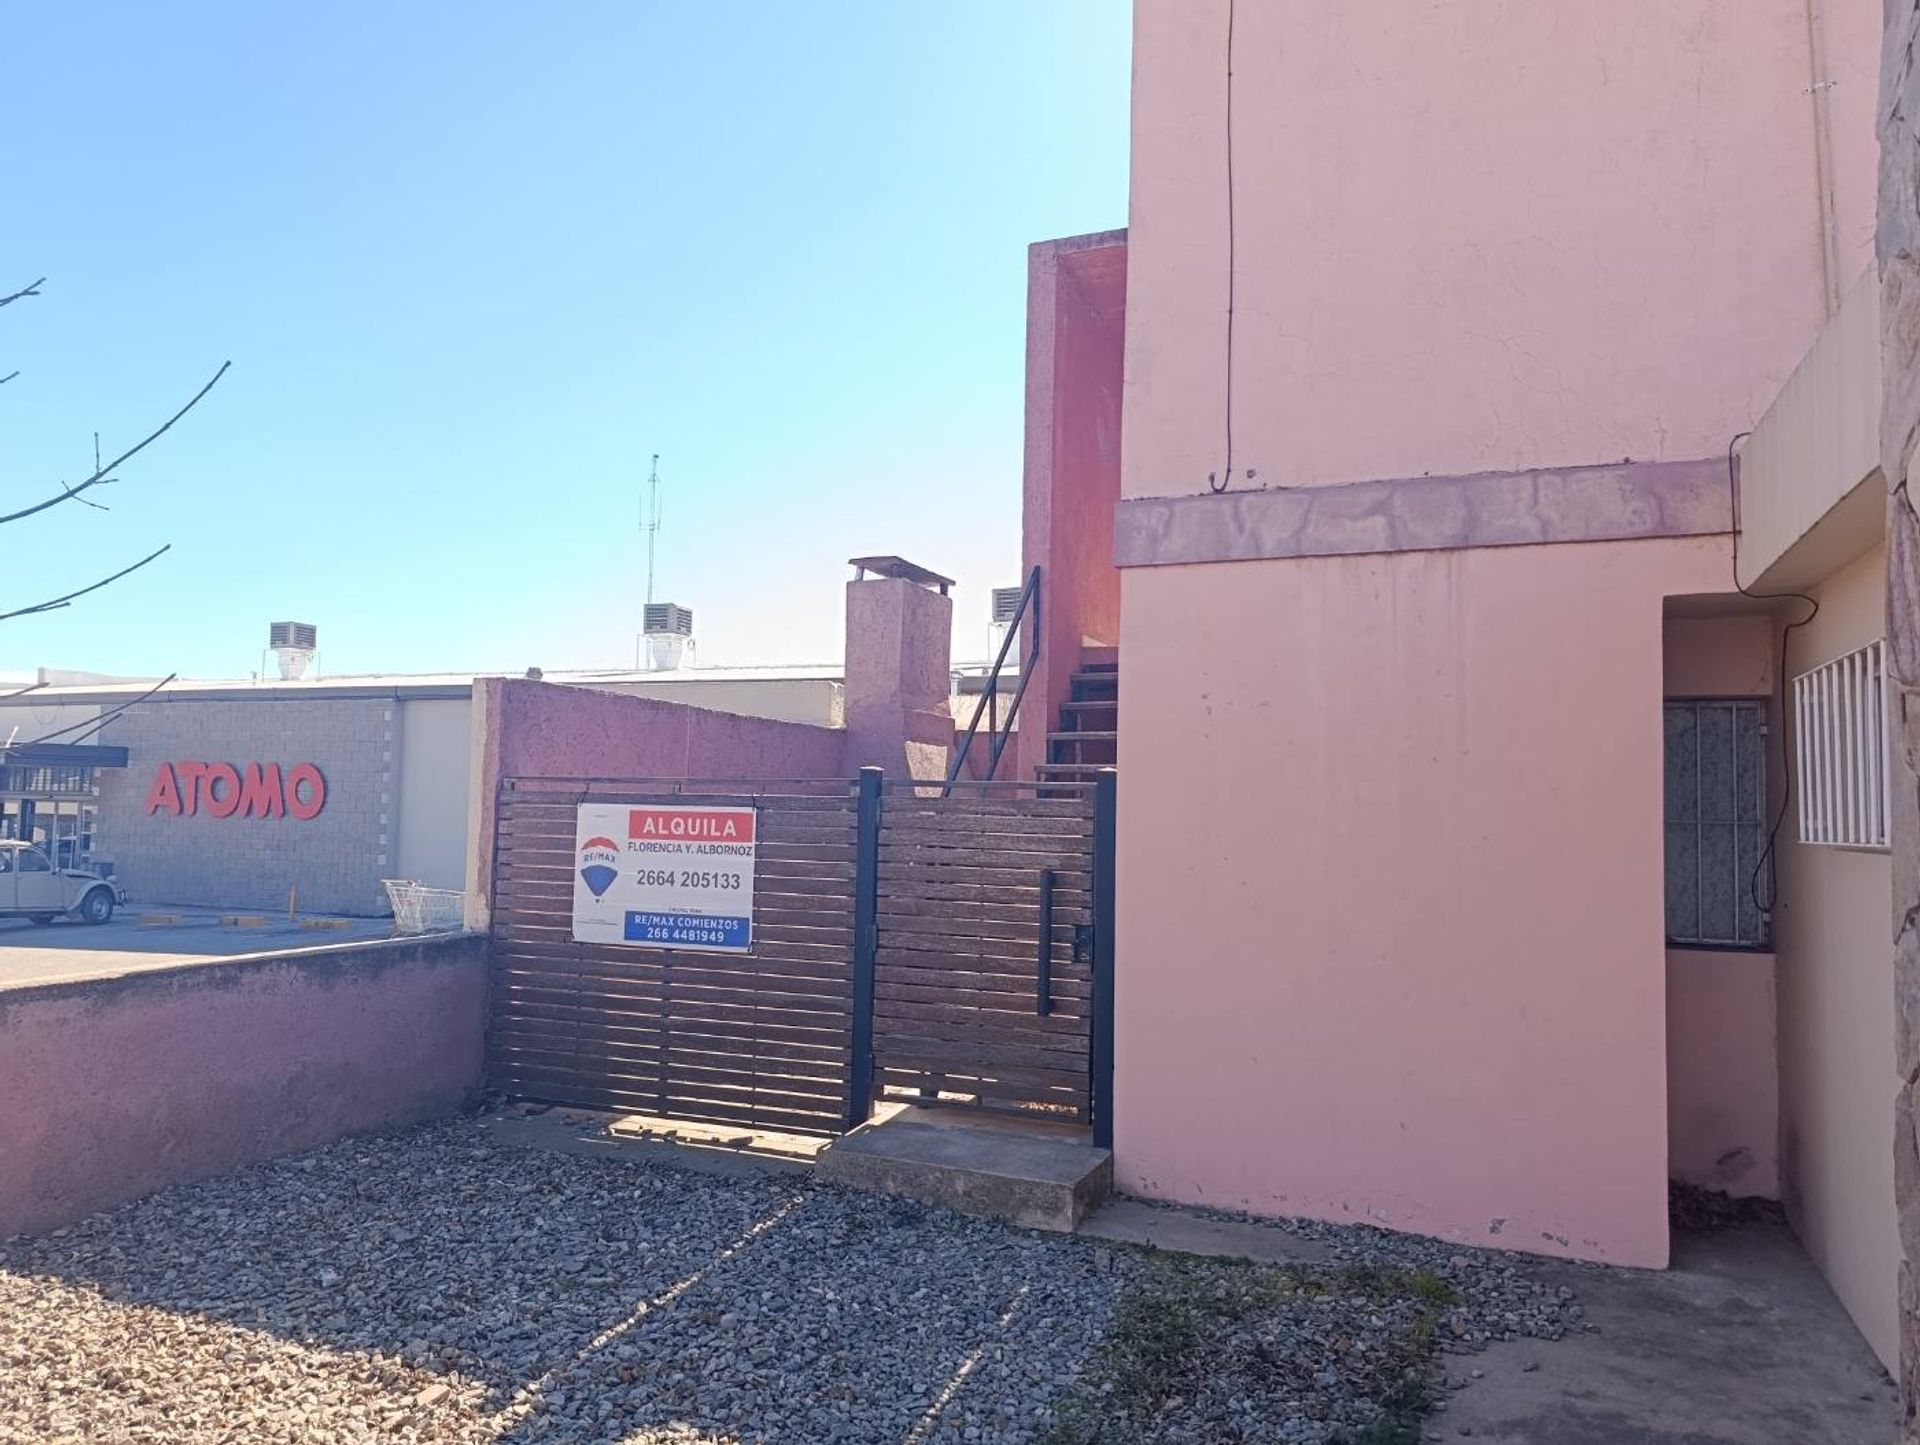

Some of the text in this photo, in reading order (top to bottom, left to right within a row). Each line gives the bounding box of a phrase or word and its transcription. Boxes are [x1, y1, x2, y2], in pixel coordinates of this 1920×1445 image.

[145, 760, 326, 820] ATOMO
[642, 817, 737, 837] ALQUILA
[627, 841, 683, 854] FLORENCIA
[695, 843, 753, 857] ALBORNOZ
[583, 852, 616, 863] RE/MAX
[636, 869, 741, 890] 2664 205133
[634, 914, 739, 930] RE/MAX COMIENZOS
[647, 927, 725, 942] 266 4481949
